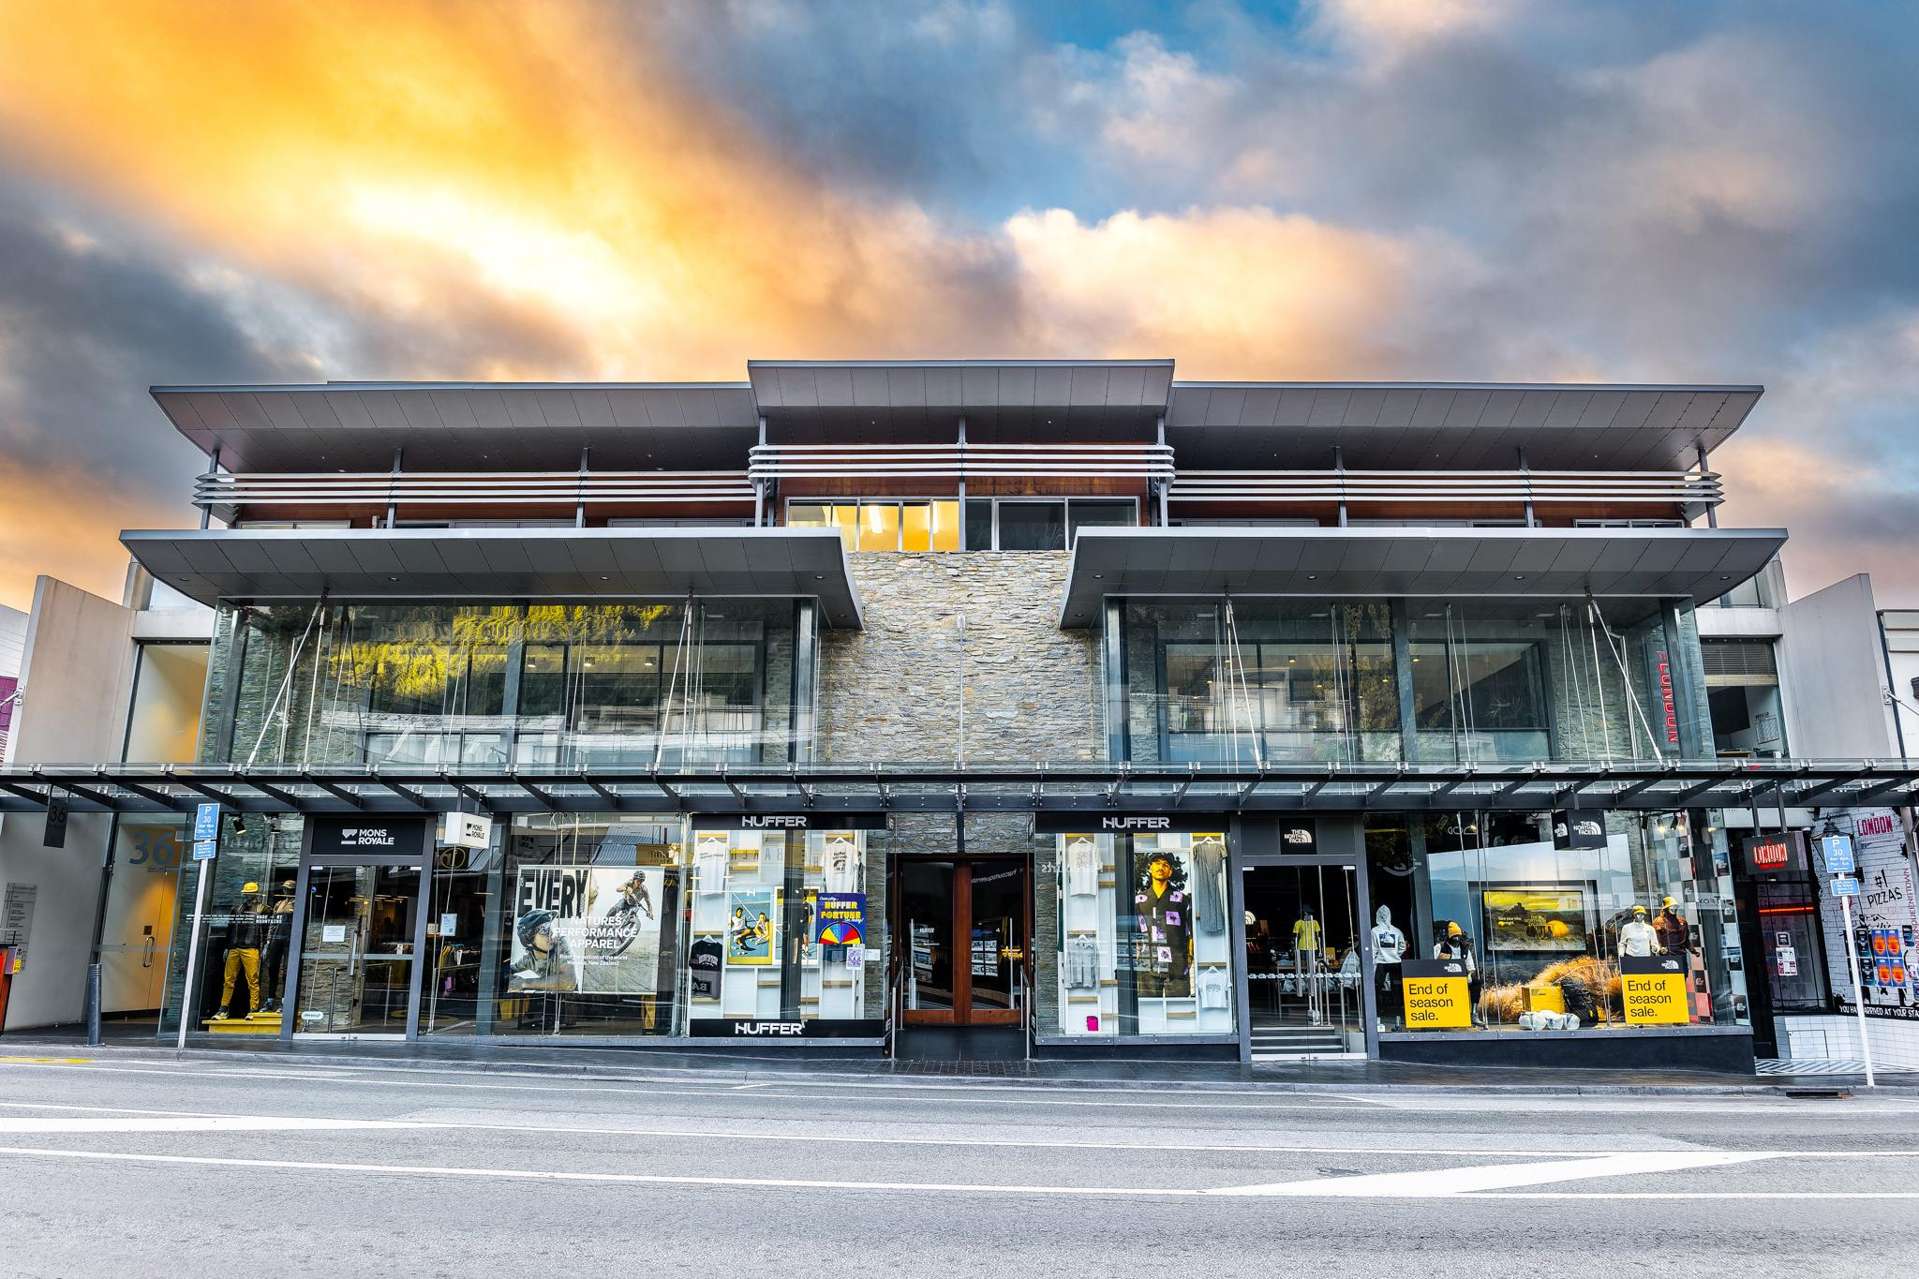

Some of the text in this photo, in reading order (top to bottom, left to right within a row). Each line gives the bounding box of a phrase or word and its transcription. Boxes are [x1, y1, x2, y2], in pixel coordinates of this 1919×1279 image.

[742, 816, 807, 827] HUFFER
[1102, 817, 1170, 829] HUFFER
[1857, 816, 1893, 836] LONDON
[359, 829, 387, 837] MONS
[358, 837, 395, 845] ROYALE
[1833, 840, 1840, 848] P
[129, 832, 174, 865] 36
[1874, 869, 1889, 887] #1
[518, 869, 590, 918] EVERY
[1867, 887, 1903, 907] PIZZAS
[820, 911, 862, 919] FORTUNE
[555, 927, 638, 938] PERFORMANCE
[571, 939, 620, 949] APPAREL
[1408, 983, 1449, 995] End of
[1627, 980, 1666, 992] End of
[1409, 998, 1454, 1009] season
[1629, 994, 1672, 1005] season
[1410, 1009, 1439, 1021] sale.
[1630, 1005, 1659, 1017] sale.
[1884, 1007, 1893, 1016] AT
[1892, 1008, 1907, 1017] YOUR
[735, 1022, 802, 1035] HUFFER
